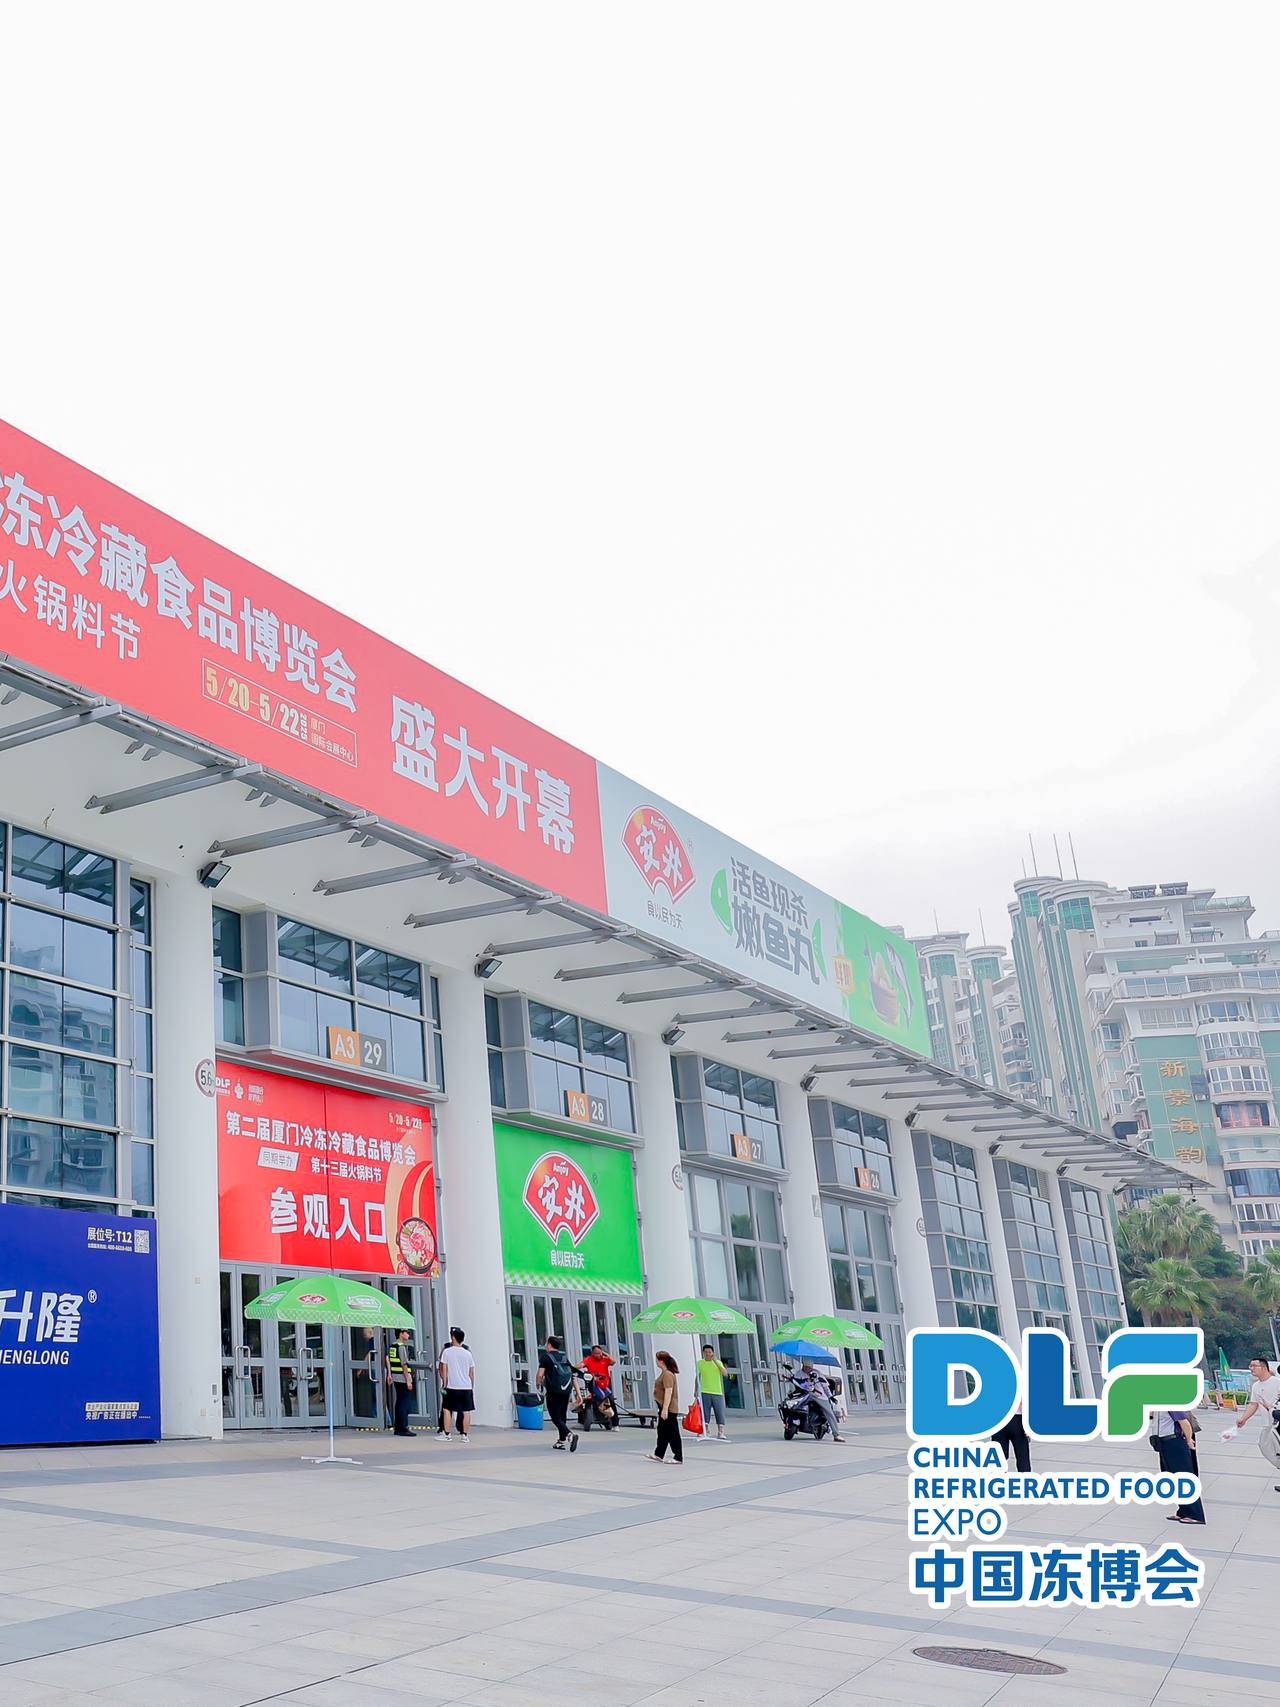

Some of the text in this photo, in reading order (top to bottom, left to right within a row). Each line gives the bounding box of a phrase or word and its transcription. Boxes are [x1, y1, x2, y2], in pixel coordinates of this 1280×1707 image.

[391, 694, 575, 855] 盛大开幕
[731, 856, 808, 929] 活鱼现杀
[732, 896, 820, 985] 嫩鱼丸
[334, 1032, 382, 1066] A3 29
[571, 1098, 605, 1122] A3 28
[226, 1110, 416, 1166] 第二届厦门冷冻冷藏食品博览会
[751, 1142, 761, 1160] 27
[311, 1157, 382, 1183] 第十三届火锅料节
[270, 1187, 387, 1244] 参观入口
[538, 1175, 586, 1228] 安井
[551, 1249, 585, 1269] 食以民为天
